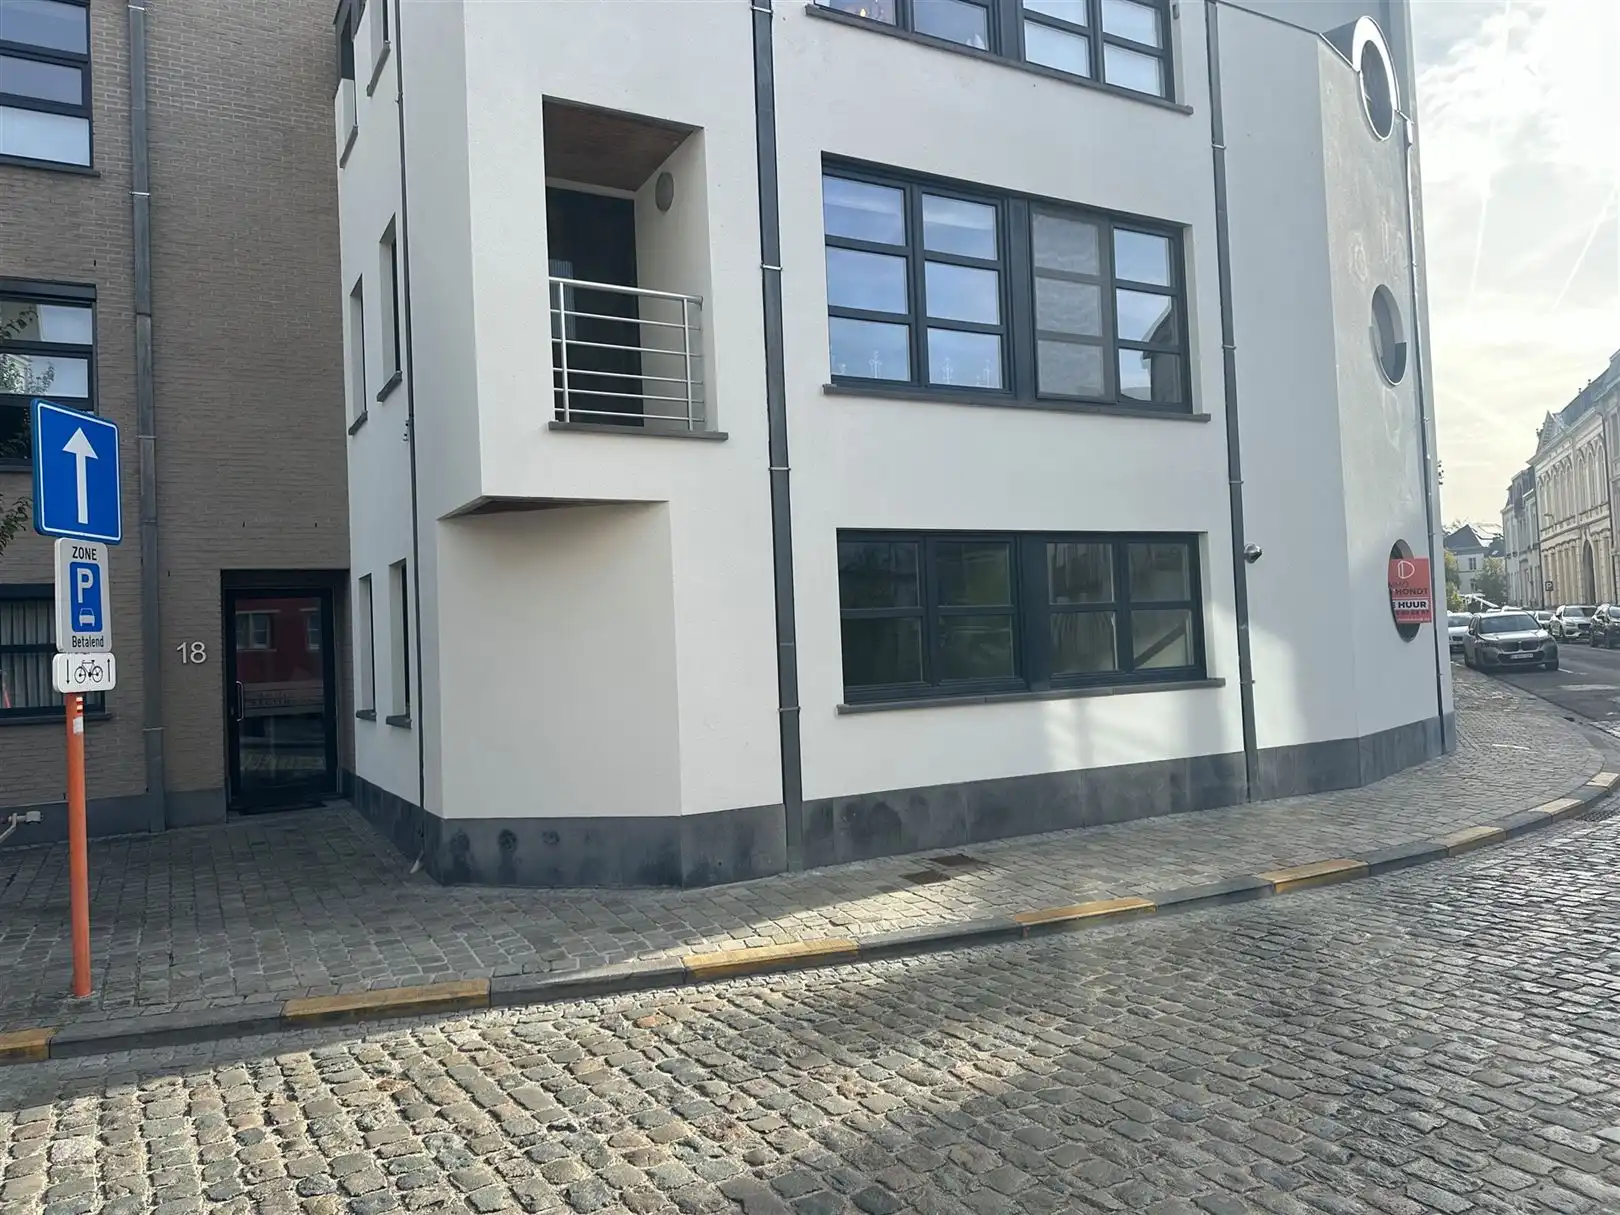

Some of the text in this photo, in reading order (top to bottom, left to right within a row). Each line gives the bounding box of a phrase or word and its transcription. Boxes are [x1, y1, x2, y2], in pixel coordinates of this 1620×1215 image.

[72, 546, 97, 560] ZONE
[77, 567, 94, 603] P
[1546, 582, 1552, 590] P
[72, 635, 104, 648] Betalend
[176, 641, 207, 664] 18
